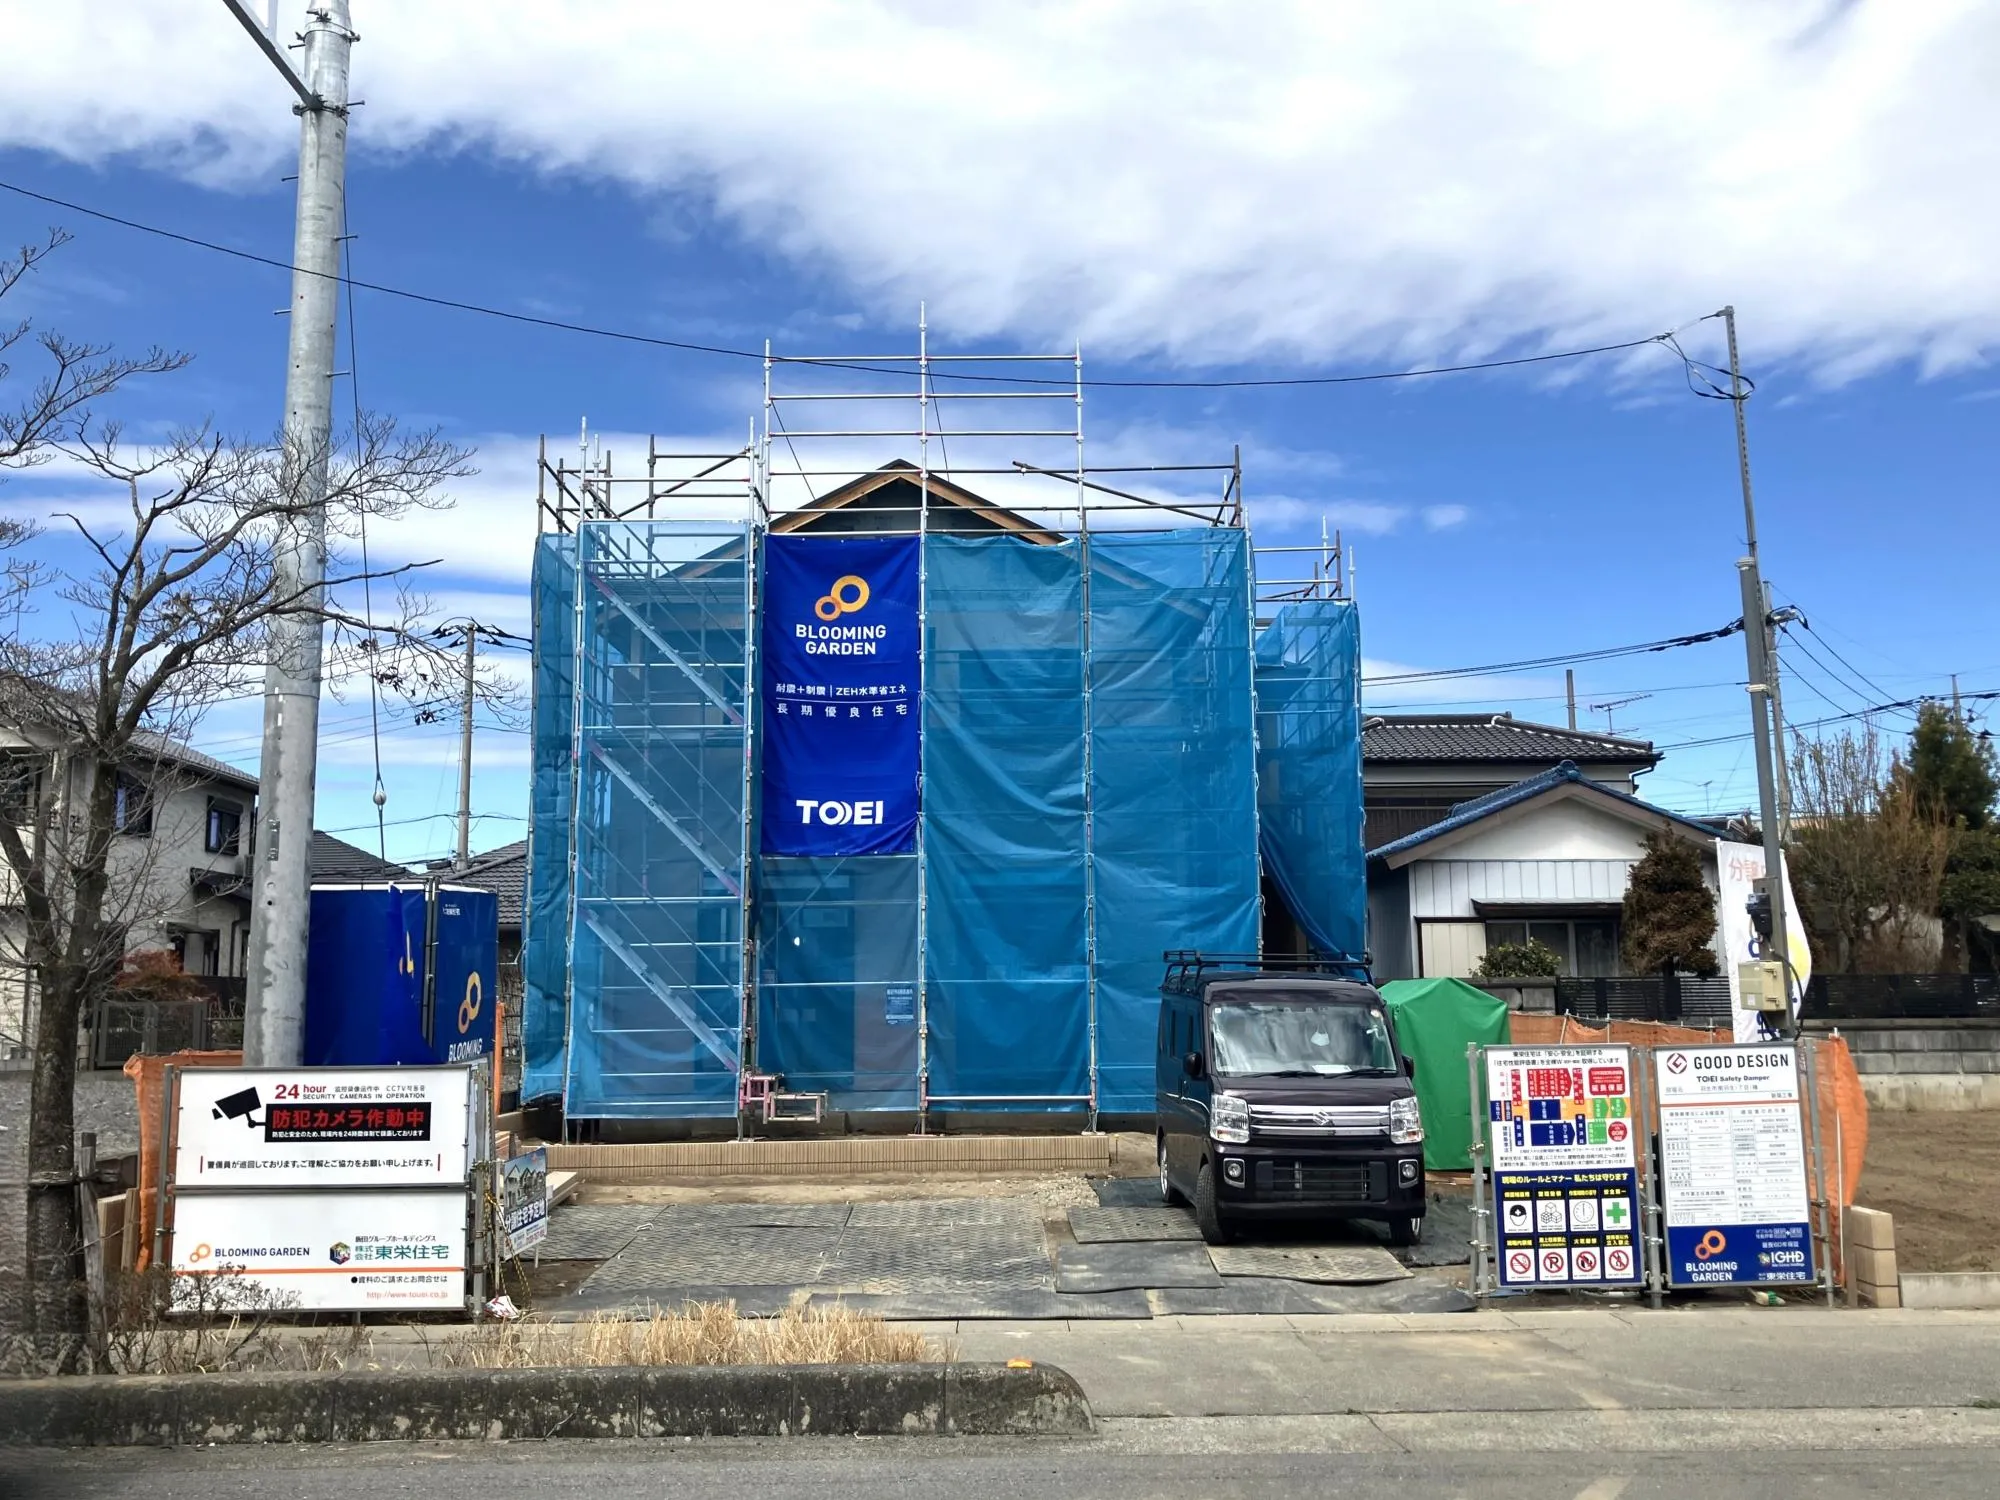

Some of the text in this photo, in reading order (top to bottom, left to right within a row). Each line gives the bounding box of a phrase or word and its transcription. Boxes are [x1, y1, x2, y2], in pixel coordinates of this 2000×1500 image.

[796, 624, 886, 640] BLOOMING
[805, 641, 876, 655] GARDEN
[449, 1038, 482, 1062] BLOOMING
[1694, 1054, 1789, 1070] GOOD DESIGN
[274, 1084, 327, 1099] 24 hour
[272, 1108, 424, 1129] 防犯カメラ作動中
[215, 1247, 310, 1257] BLOOMING GARDEN
[375, 1244, 449, 1260] 東栄住宅
[1685, 1261, 1738, 1272] BLOOMING
[1692, 1272, 1732, 1282] GARDEN
[1766, 1272, 1806, 1280] 東栄住宅
